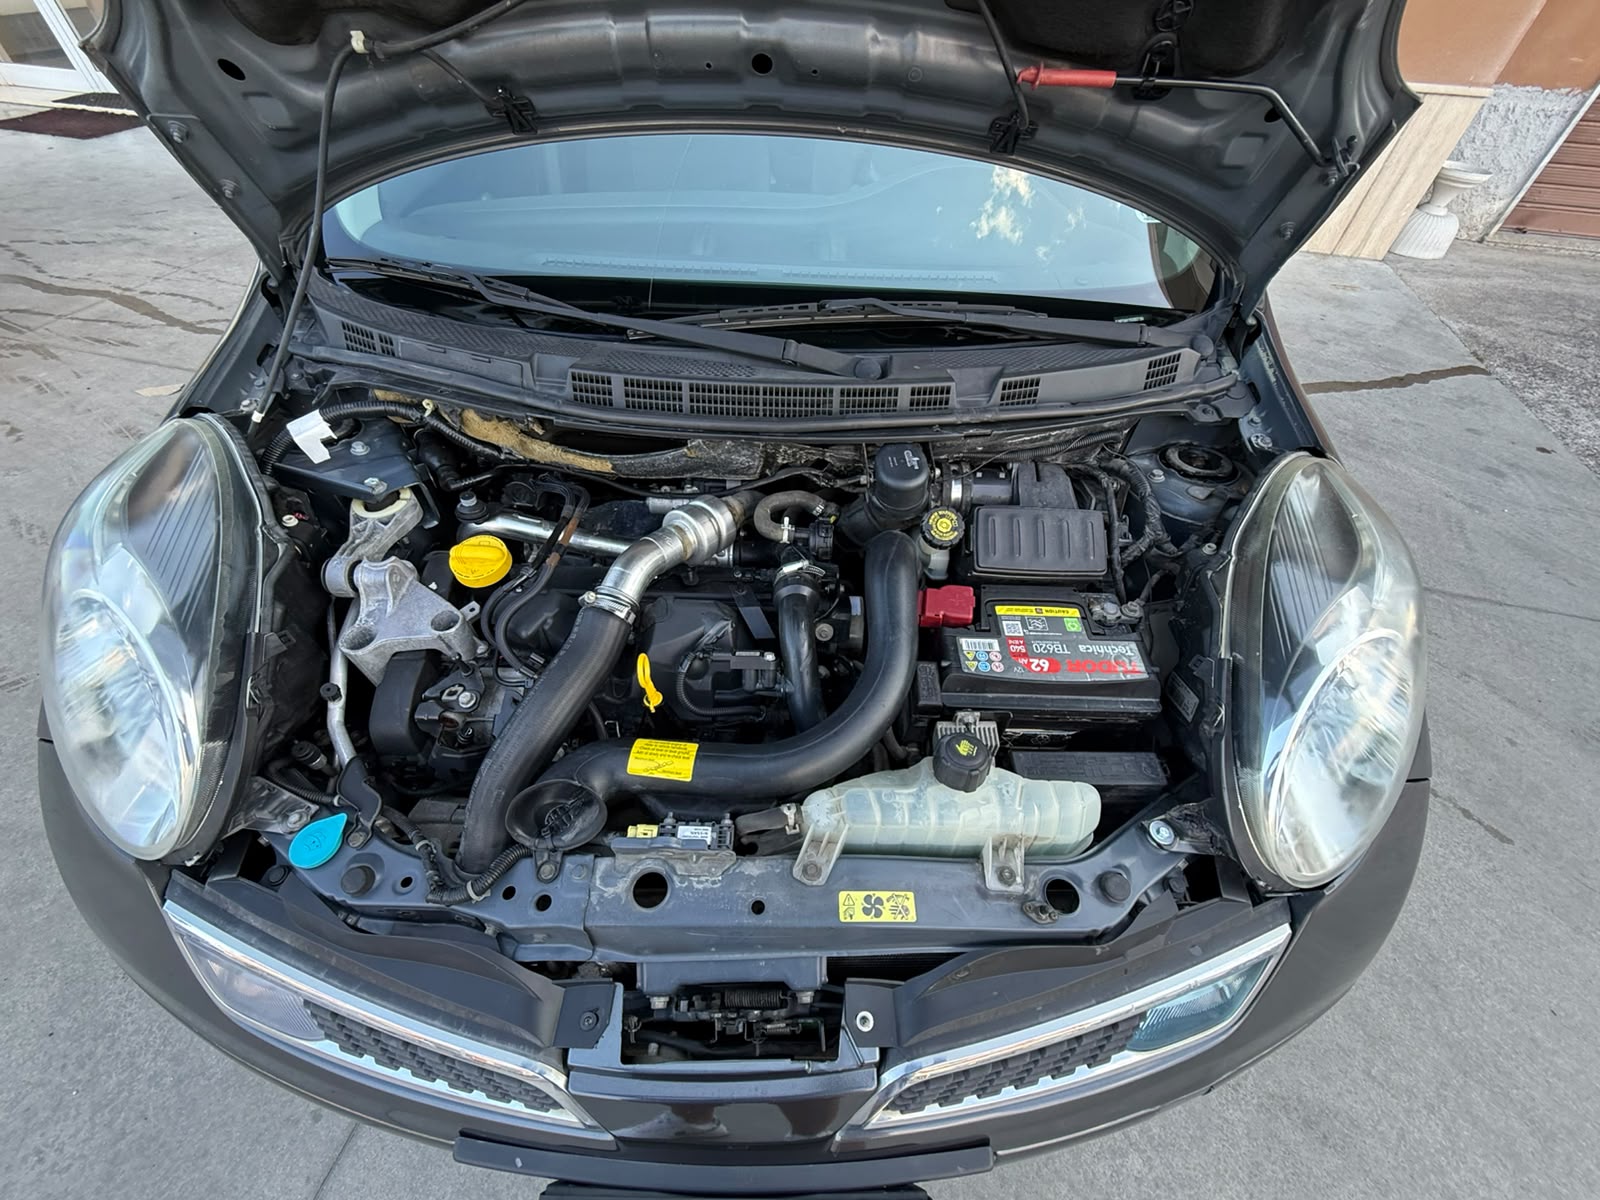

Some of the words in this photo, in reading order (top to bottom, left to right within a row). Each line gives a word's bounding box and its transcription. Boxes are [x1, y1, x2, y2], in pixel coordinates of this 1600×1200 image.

[1010, 645, 1026, 653] 540
[1033, 643, 1071, 654] TB620
[1078, 644, 1134, 655] Technica
[1030, 659, 1049, 672] 62
[1066, 659, 1143, 674] TUDOR
